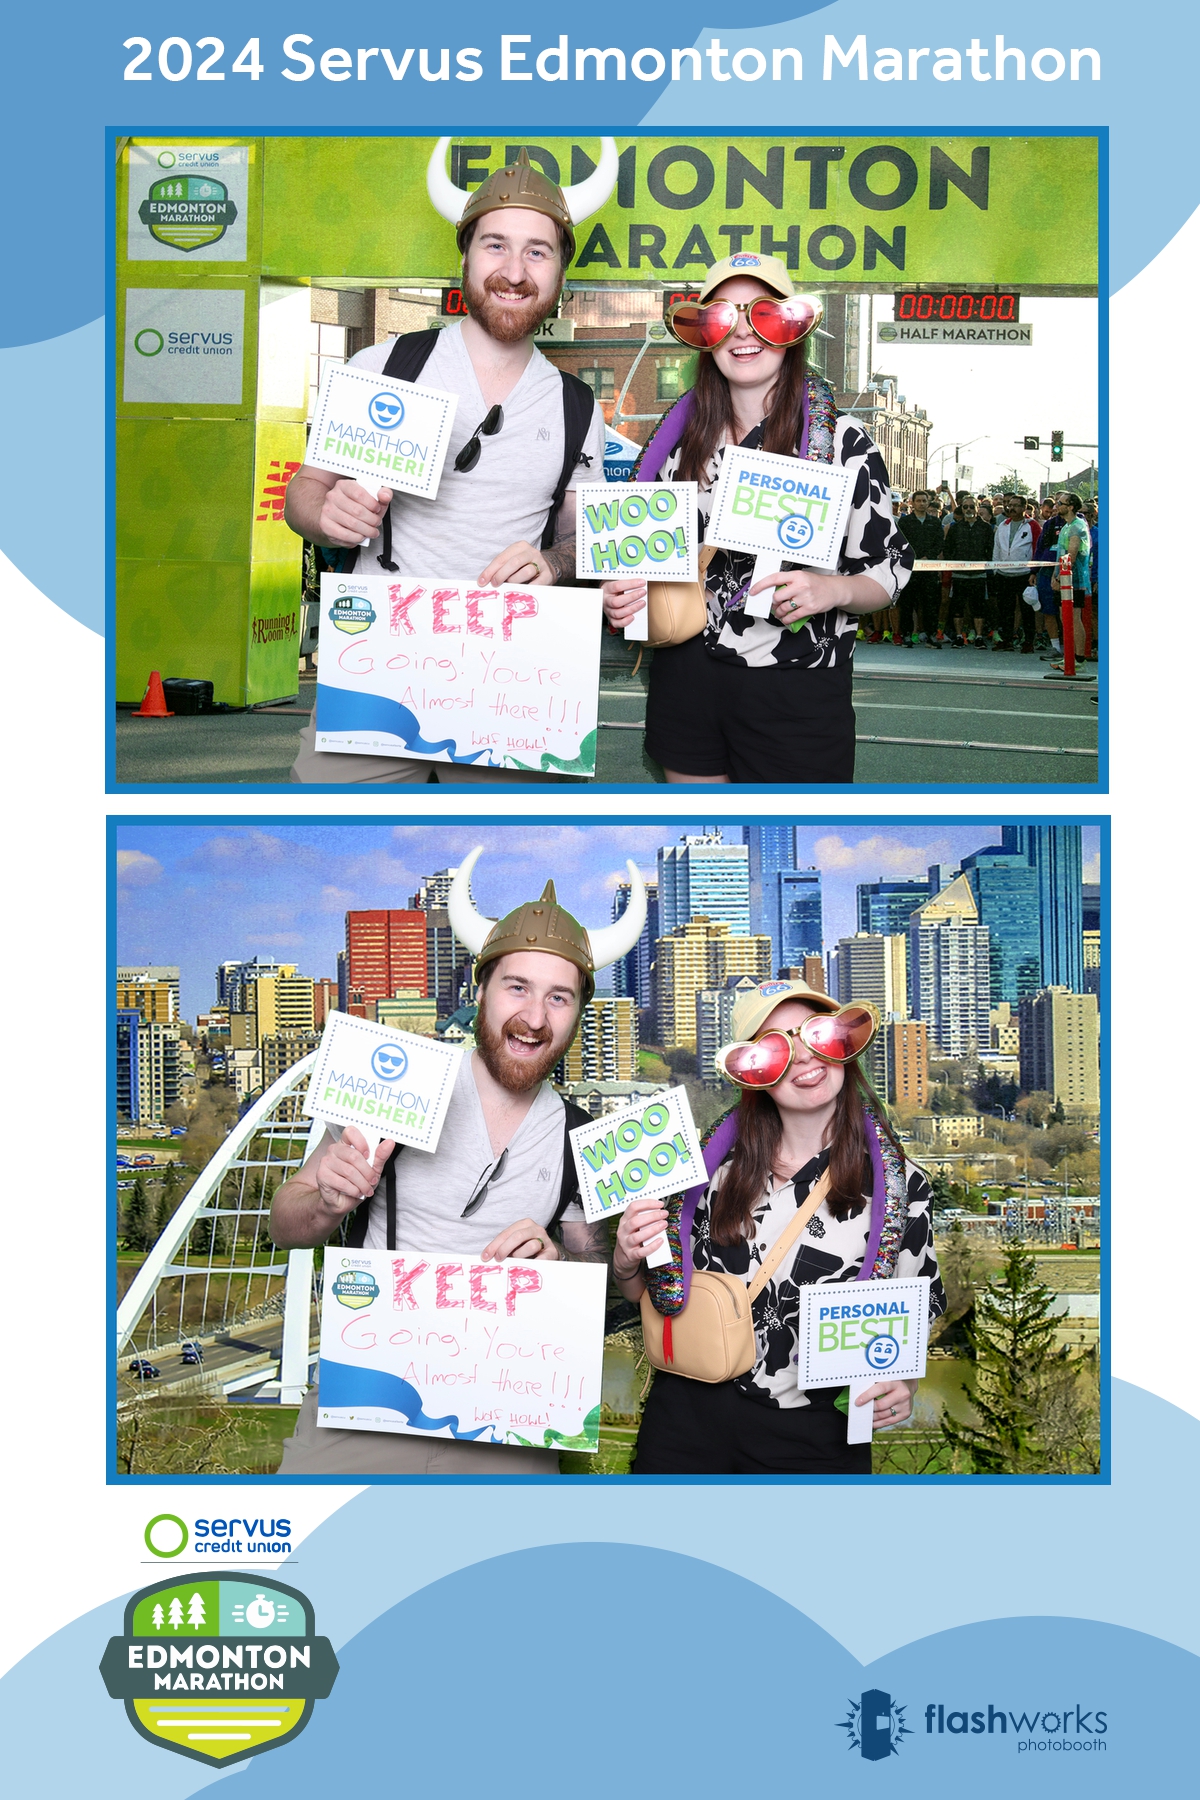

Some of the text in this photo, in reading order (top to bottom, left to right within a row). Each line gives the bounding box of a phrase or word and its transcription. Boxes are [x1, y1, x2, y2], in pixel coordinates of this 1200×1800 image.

[178, 152, 219, 162] servus
[150, 203, 227, 214] EDMONTON
[160, 214, 215, 222] MARATHON
[574, 222, 906, 271] ARATHON
[734, 259, 756, 267] 66
[168, 331, 233, 345] servus
[168, 345, 233, 355] credit union
[900, 328, 1031, 342] HALF MARATHON
[323, 437, 425, 477] FINISHER!
[327, 420, 429, 461] MARATHON
[604, 467, 631, 477] nion
[738, 470, 832, 501] PERSONAL
[585, 489, 678, 534] WOO
[732, 484, 830, 531] BEST!
[590, 526, 688, 573] HOO!
[333, 609, 372, 617] EDMONTON
[387, 584, 539, 641] KEEP
[338, 639, 465, 681] Going!
[399, 686, 581, 735] Almost there!!!
[765, 983, 788, 995] 66
[323, 1086, 426, 1130] FINISHER!
[328, 1070, 430, 1114] MARATHON
[581, 1103, 670, 1173] WOO
[595, 1132, 691, 1211] HOO!
[337, 1284, 375, 1292] EDMONTON
[391, 1258, 543, 1316] KEEP
[820, 1301, 909, 1320] PERSONAL
[341, 1314, 468, 1356] Going!
[818, 1315, 909, 1353] BEST!
[401, 1362, 585, 1411] Almost there!!!
